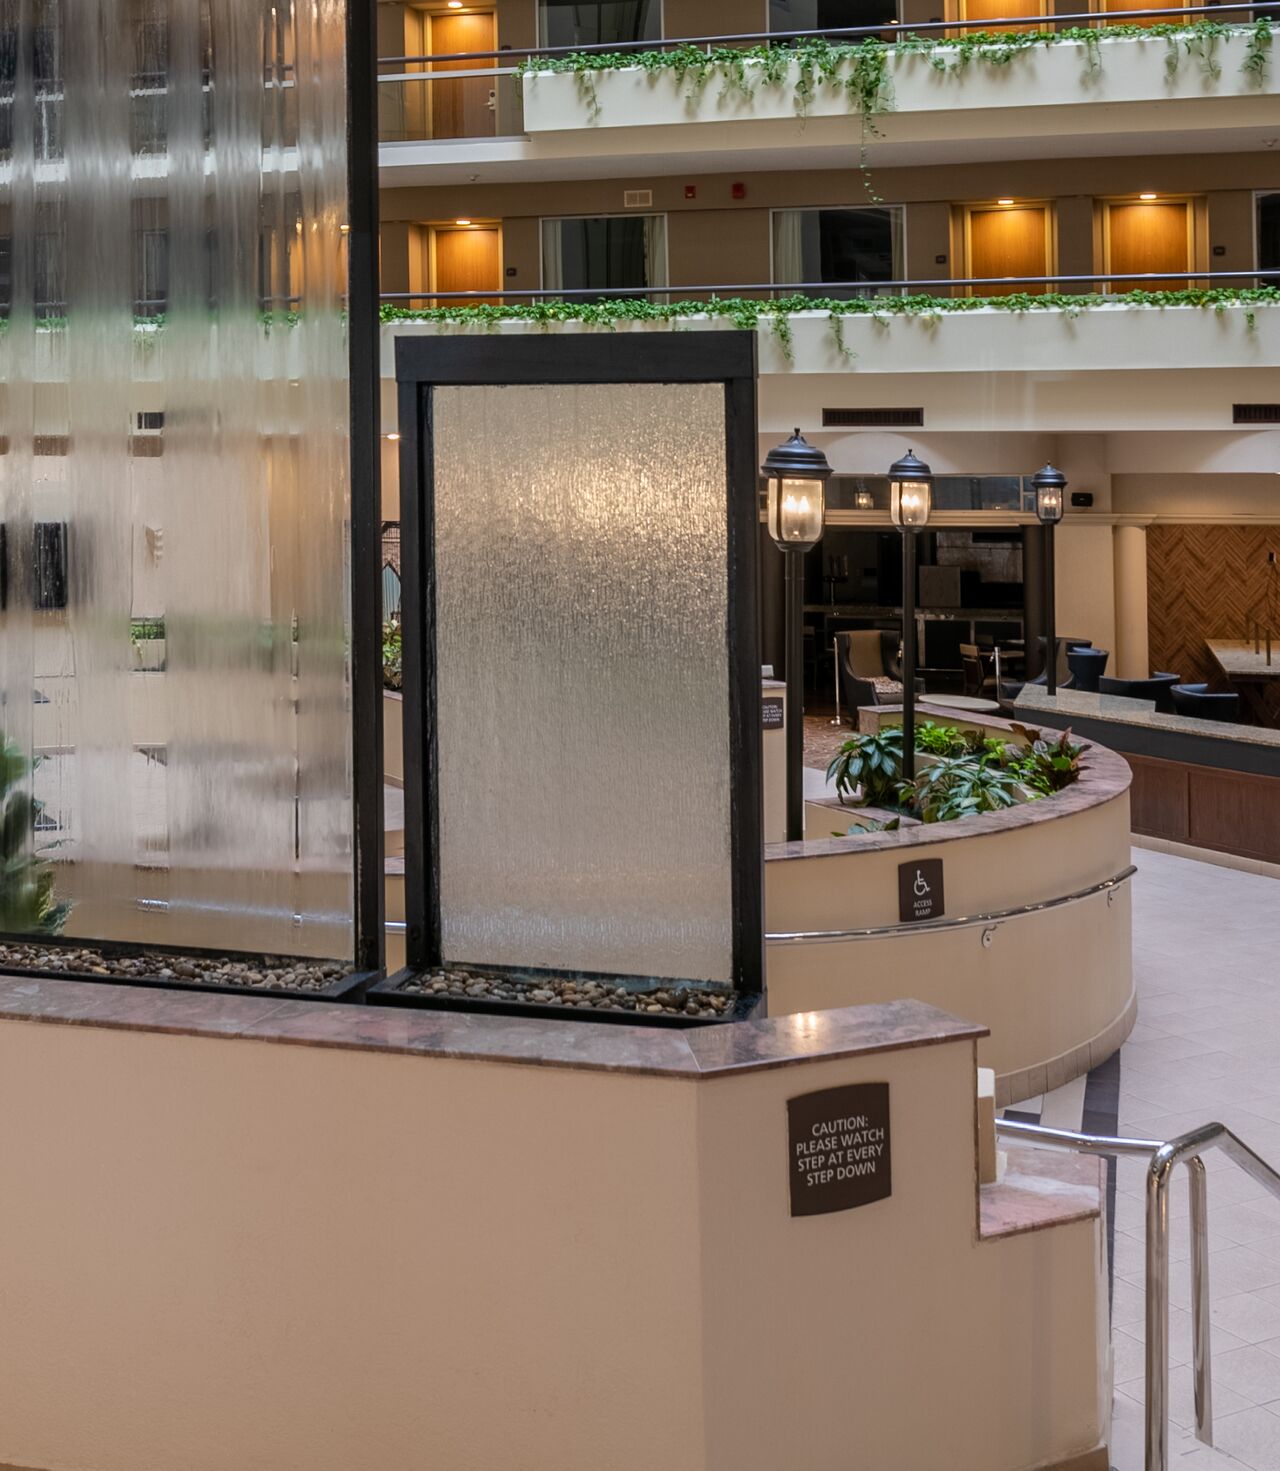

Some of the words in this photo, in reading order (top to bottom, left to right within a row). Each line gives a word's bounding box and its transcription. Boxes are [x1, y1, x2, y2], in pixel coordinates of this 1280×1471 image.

[914, 899, 932, 908] ACCESS
[812, 1115, 868, 1136] CAUTION:
[796, 1136, 838, 1156] PLEASE
[841, 1127, 884, 1147] WATCH
[798, 1154, 825, 1172] STEP
[828, 1150, 844, 1166] AT
[847, 1143, 883, 1162] EVERY
[807, 1168, 833, 1187] STEP
[837, 1160, 876, 1180] DOWN
